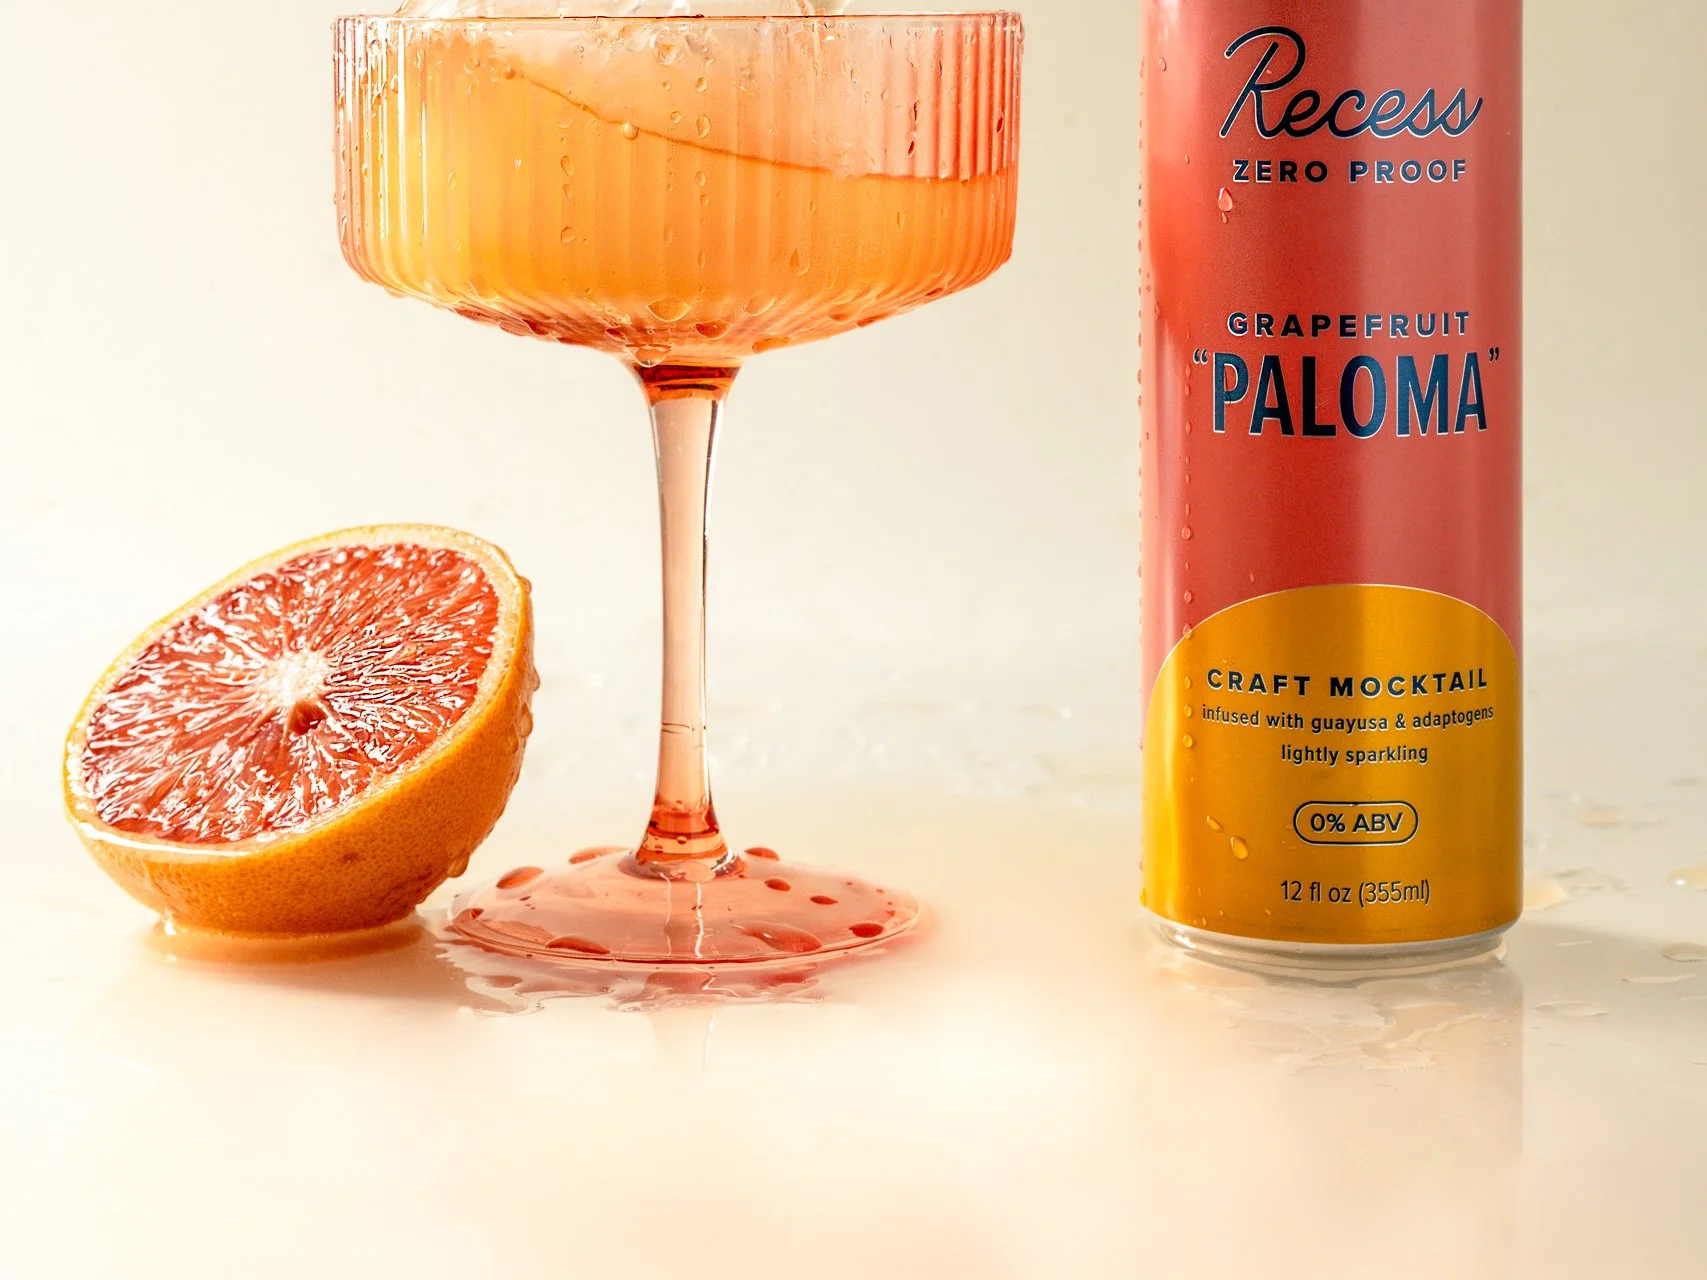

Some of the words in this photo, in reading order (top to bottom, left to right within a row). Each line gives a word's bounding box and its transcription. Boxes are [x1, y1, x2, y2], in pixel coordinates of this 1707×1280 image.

[1219, 25, 1483, 138] Recess
[1233, 159, 1328, 183] ZERO
[1349, 159, 1466, 184] PROOF
[1227, 311, 1469, 339] GRAPEFRUIT
[1206, 668, 1310, 697] CRAFT
[1329, 667, 1488, 698] MOCKTAIL
[1202, 704, 1260, 727] infused
[1266, 711, 1304, 730] with
[1311, 714, 1388, 734] guayusa
[1395, 713, 1406, 729] &
[1412, 705, 1494, 729] adaptogens
[1281, 744, 1339, 766] lightly
[1345, 745, 1429, 766] sparkling
[1309, 812, 1346, 833] 0%
[1352, 812, 1403, 833] ABV
[1280, 880, 1302, 902] 12
[1310, 881, 1321, 903] fl
[1329, 885, 1351, 904] oz
[1358, 880, 1431, 908] (355ml)
